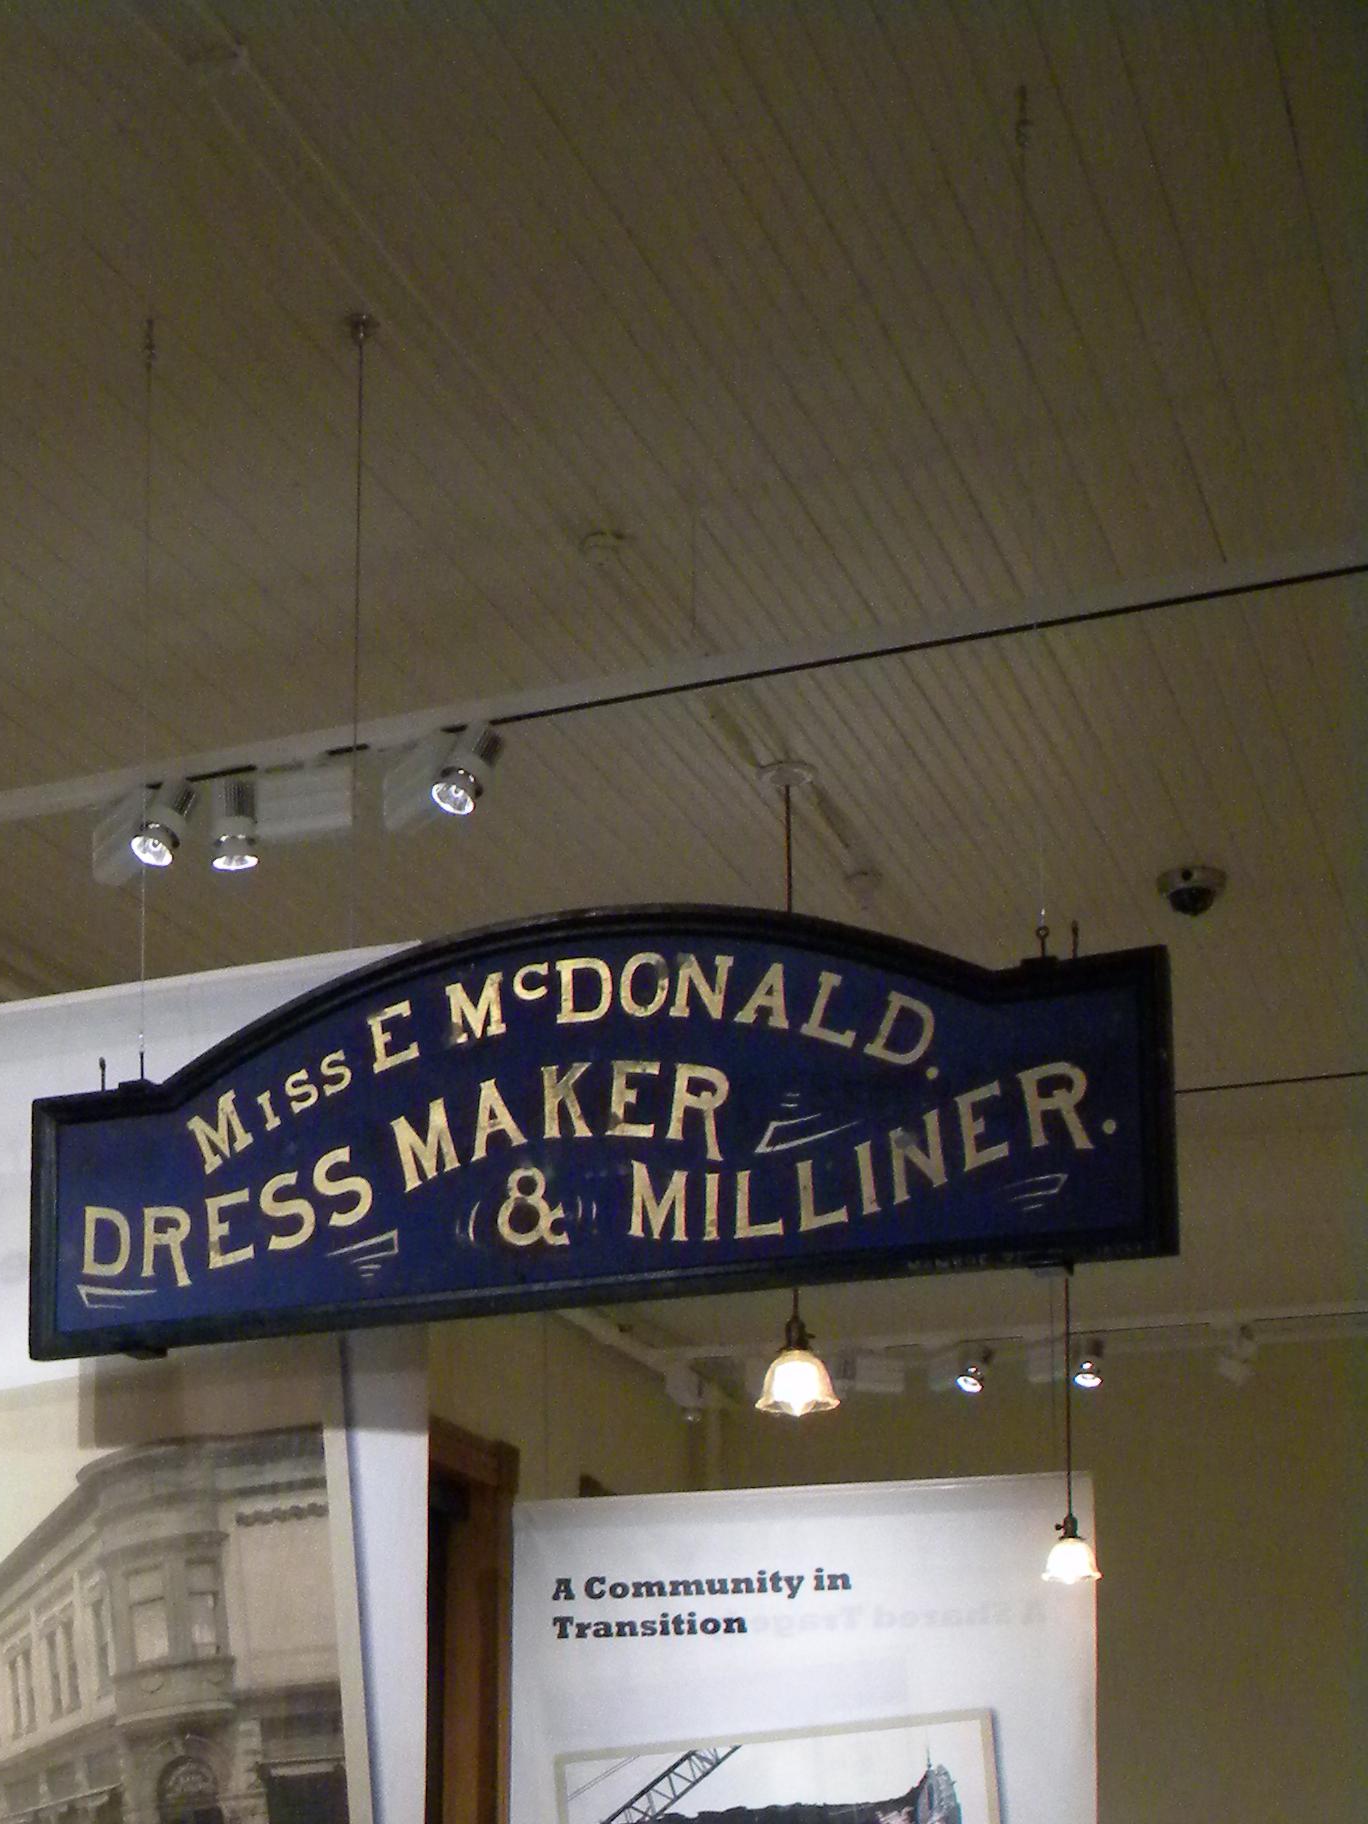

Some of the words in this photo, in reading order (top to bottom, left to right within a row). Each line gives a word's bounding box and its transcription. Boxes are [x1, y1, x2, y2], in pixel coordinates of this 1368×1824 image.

[367, 999, 420, 1074] E
[83, 1146, 372, 1287] DRESS
[390, 1061, 729, 1192] MAKER
[497, 1167, 570, 1246] &
[630, 1062, 1118, 1242] MILLINER.
[552, 1577, 576, 1601] A
[584, 1570, 805, 1600] Community
[814, 1567, 851, 1592] in
[552, 1614, 747, 1639] Transition
